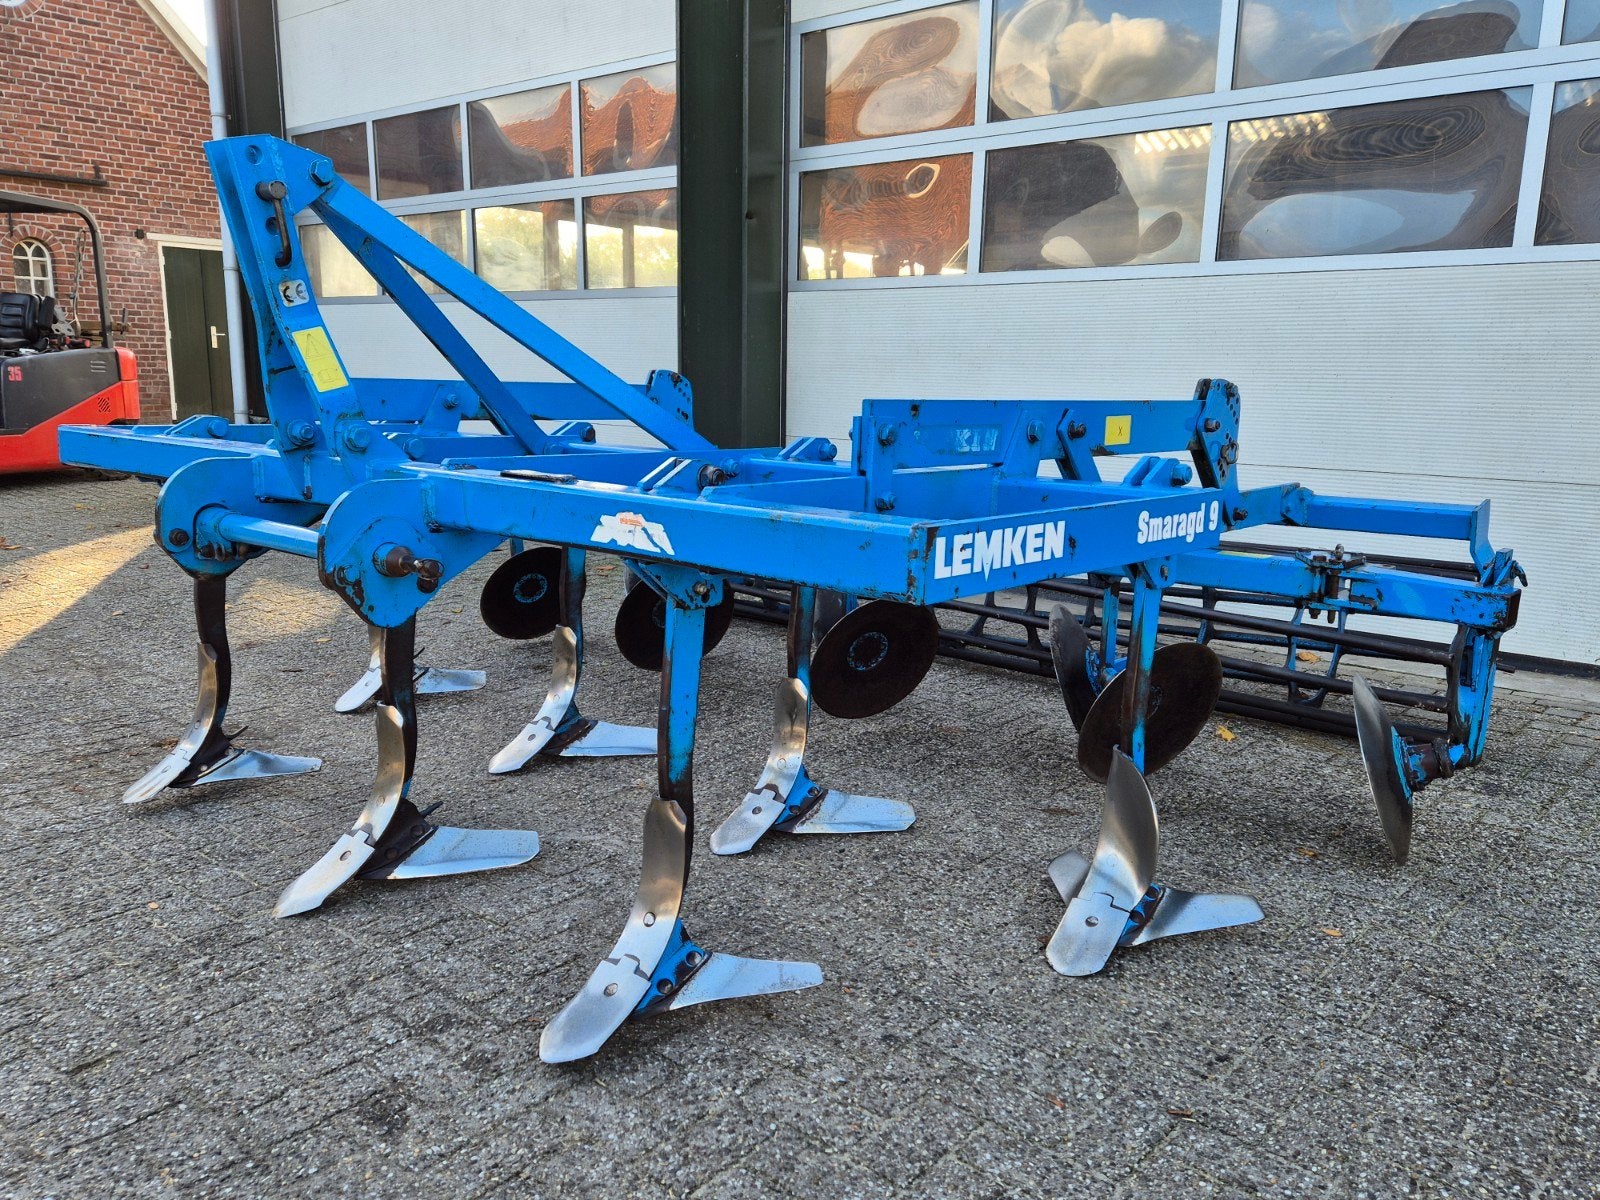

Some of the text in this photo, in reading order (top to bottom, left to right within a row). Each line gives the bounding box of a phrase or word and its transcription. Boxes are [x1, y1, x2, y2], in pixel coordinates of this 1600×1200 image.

[7, 366, 23, 381] 35
[1136, 499, 1219, 545] Smaragd 9
[934, 520, 1066, 582] LEMKEN
